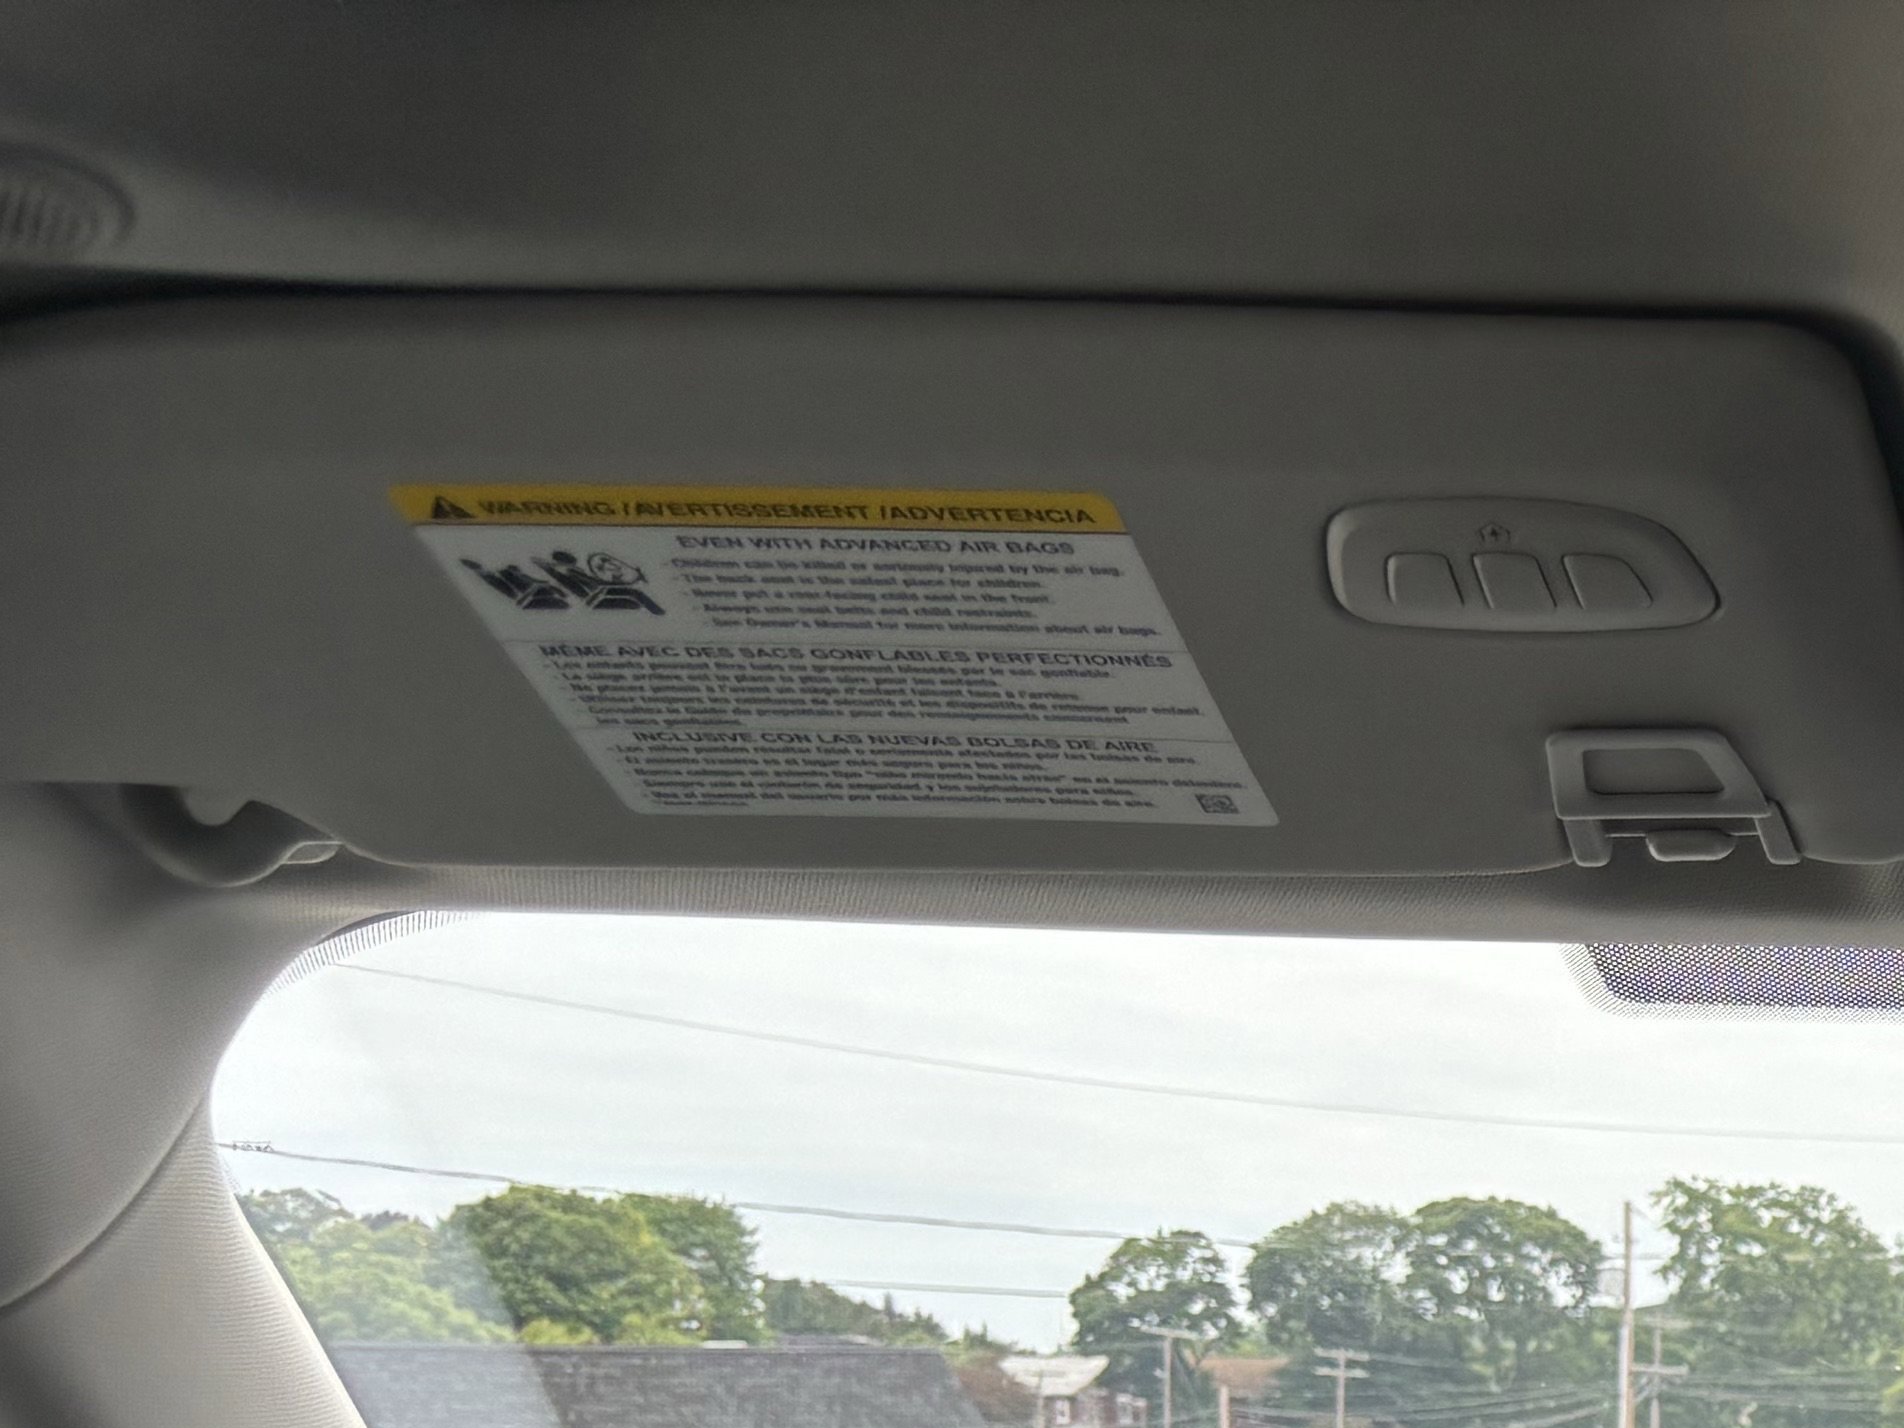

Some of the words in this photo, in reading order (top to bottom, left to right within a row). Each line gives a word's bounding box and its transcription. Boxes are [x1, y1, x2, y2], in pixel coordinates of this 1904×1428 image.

[478, 500, 617, 516] WARNING
[677, 535, 743, 549] EVEN
[751, 536, 813, 550] WITH
[820, 538, 952, 554] ADVANCED
[959, 541, 1002, 554] AIR
[1008, 542, 1074, 555] BAGS
[539, 644, 606, 657] MÊME
[618, 645, 680, 658] AVEC
[686, 646, 733, 658] DES
[742, 647, 803, 658] SACS
[811, 649, 971, 664] GONFLABLES
[978, 650, 1173, 668] PERFECTIONNÉS
[633, 730, 753, 743] INCLUSIVE
[762, 732, 811, 743] CON
[818, 733, 864, 746] LAS
[868, 735, 961, 747] NUEVAS
[967, 736, 1061, 750] BOLSAS
[1071, 739, 1099, 751] DE
[1105, 740, 1158, 753] AIRE
